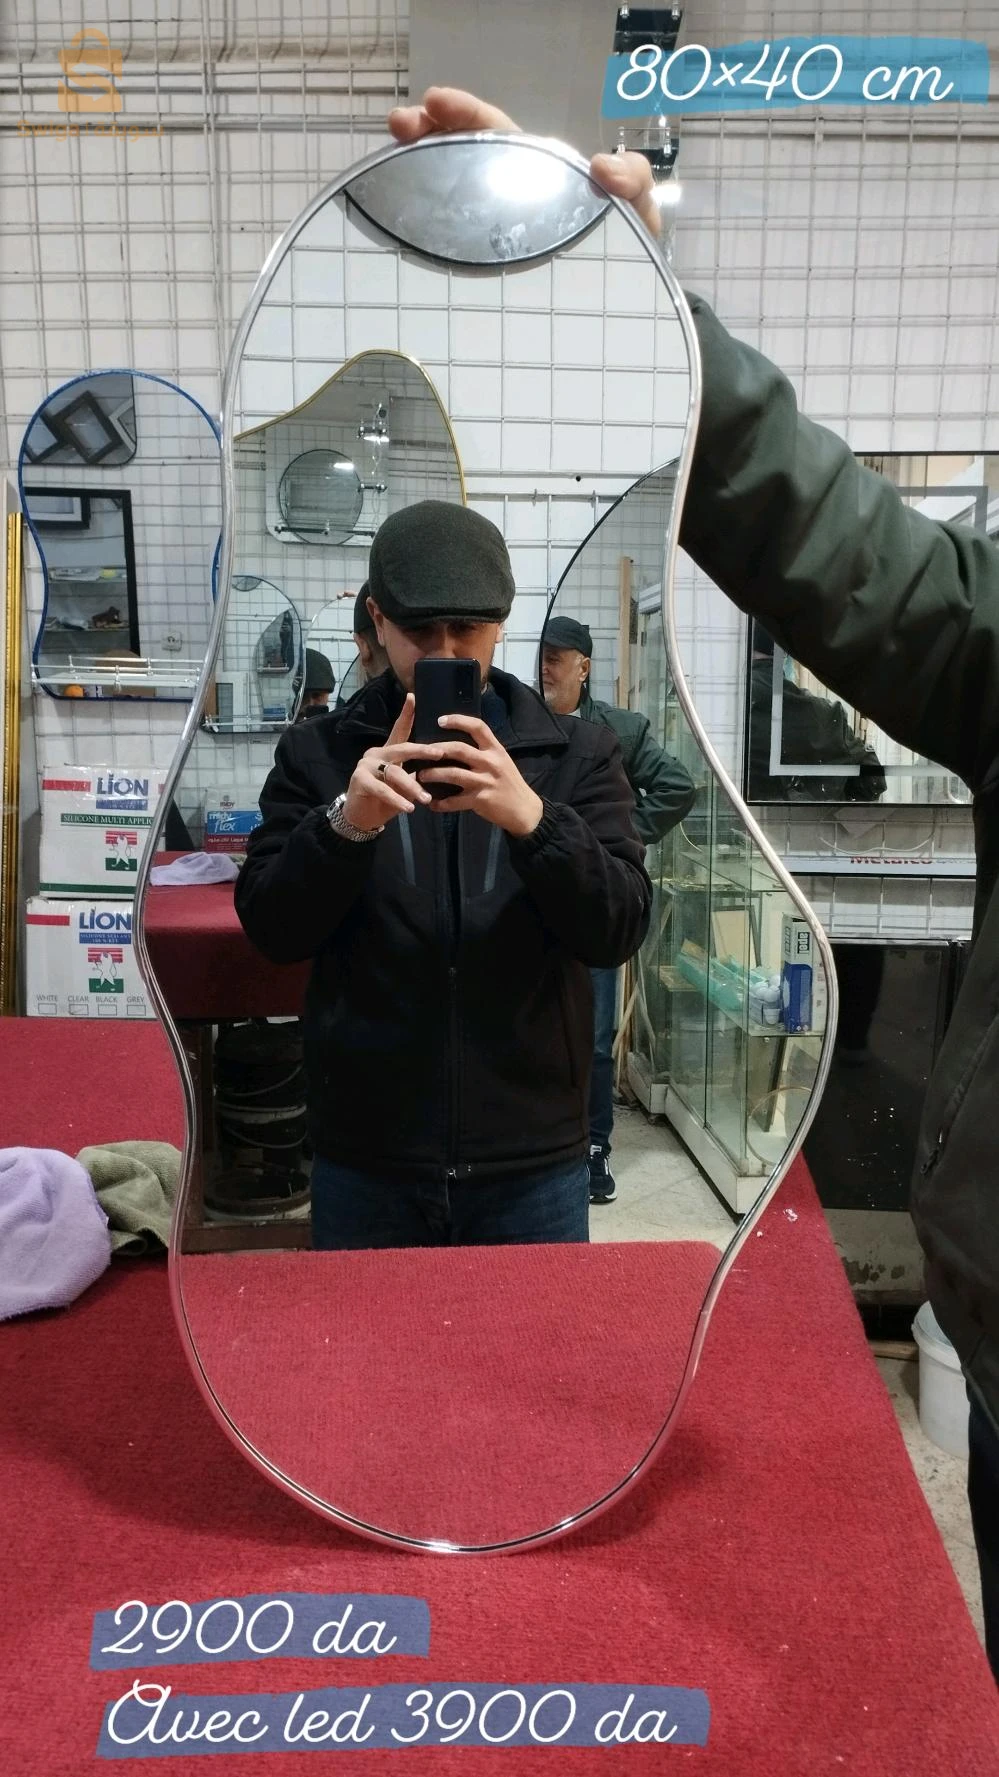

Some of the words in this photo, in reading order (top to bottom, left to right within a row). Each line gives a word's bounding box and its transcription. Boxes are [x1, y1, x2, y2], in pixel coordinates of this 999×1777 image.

[97, 773, 149, 796] LION
[63, 814, 98, 823] SILICONE
[100, 816, 126, 824] MULTI
[79, 906, 132, 931] LION
[37, 994, 58, 1002] WHITE
[67, 995, 89, 1003] CLEAR
[96, 995, 118, 1003] BLACK
[126, 996, 145, 1004] GREY
